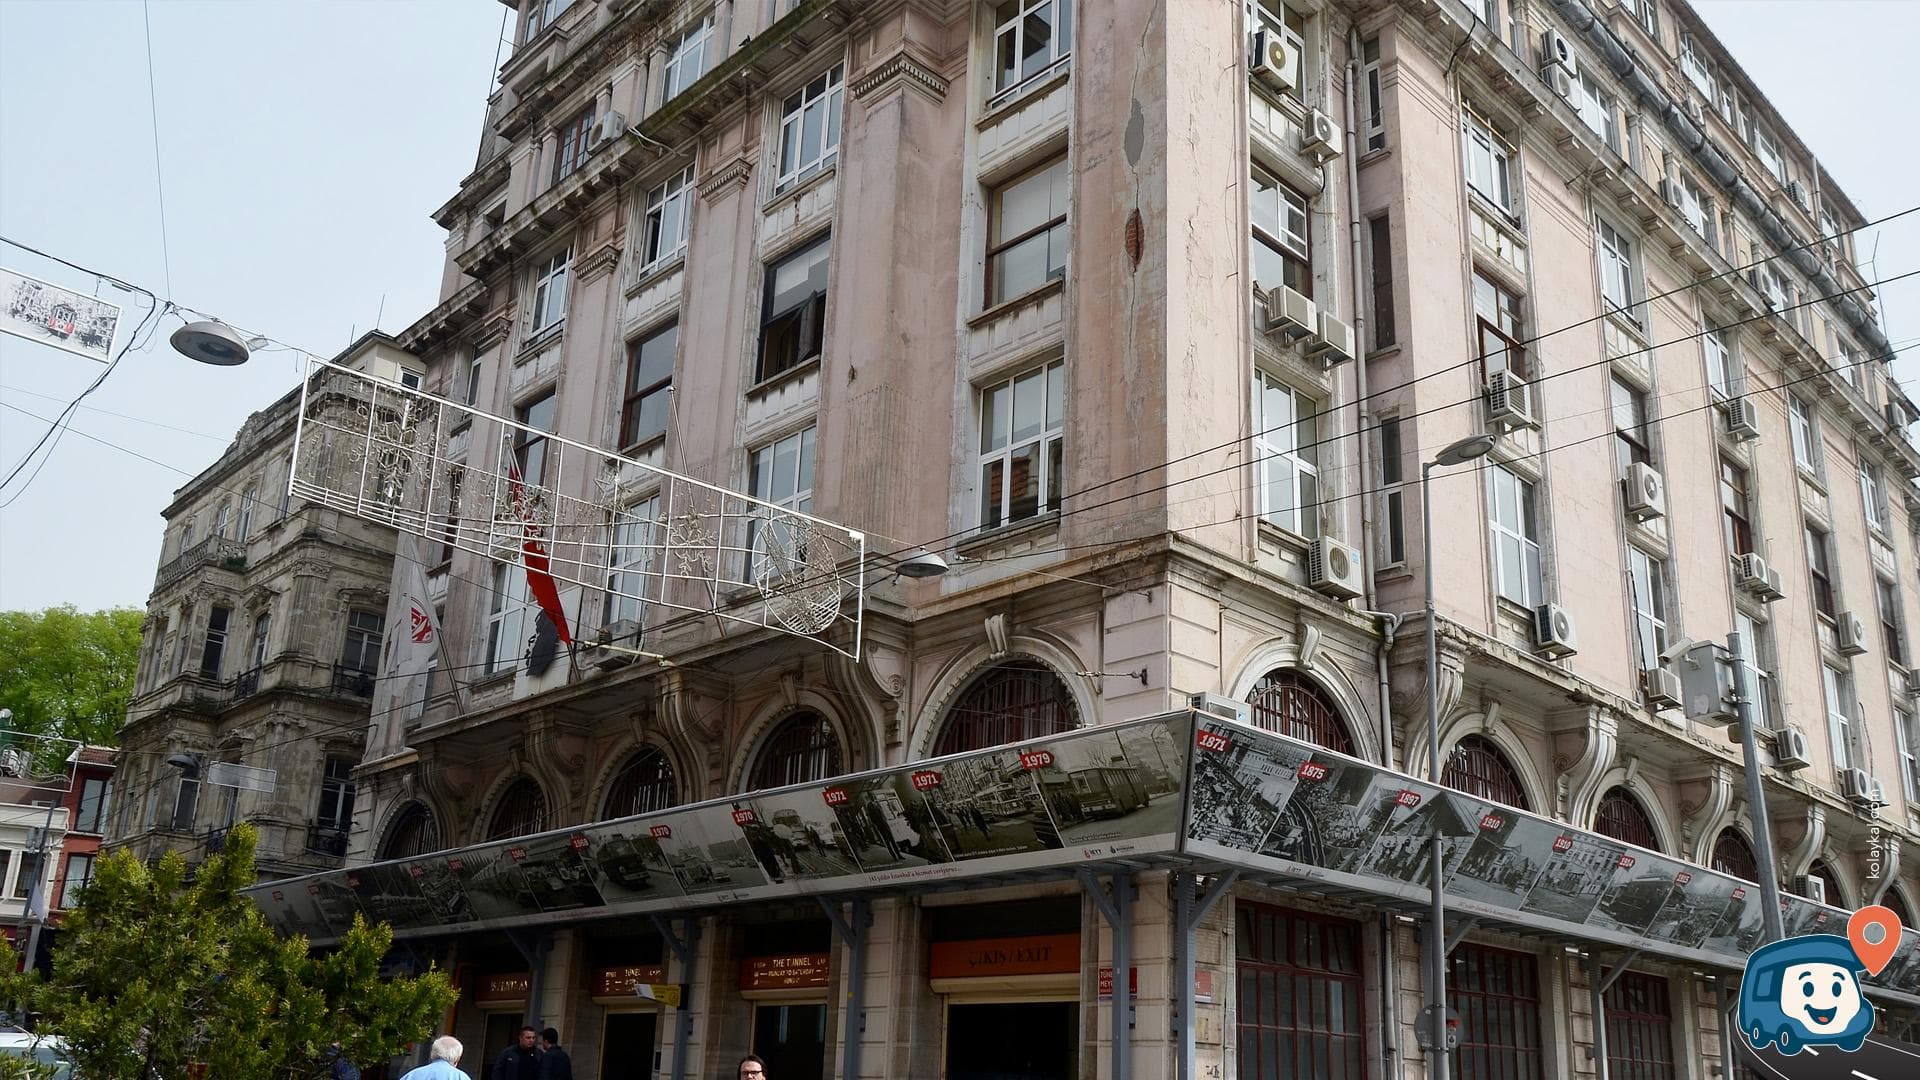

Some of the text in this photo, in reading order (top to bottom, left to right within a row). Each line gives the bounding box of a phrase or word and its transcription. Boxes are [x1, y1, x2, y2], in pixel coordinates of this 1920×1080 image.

[1199, 734, 1227, 752] 1871
[1024, 752, 1051, 767] 1979
[1301, 764, 1325, 779] 1875
[915, 772, 939, 787] 1971
[825, 790, 848, 803] 1971
[1398, 792, 1420, 806] 1897
[735, 810, 753, 823] 1970
[1482, 817, 1501, 830] 1910
[653, 825, 669, 837] 1970
[1554, 838, 1572, 850] 1910
[1017, 946, 1054, 962] EXIT
